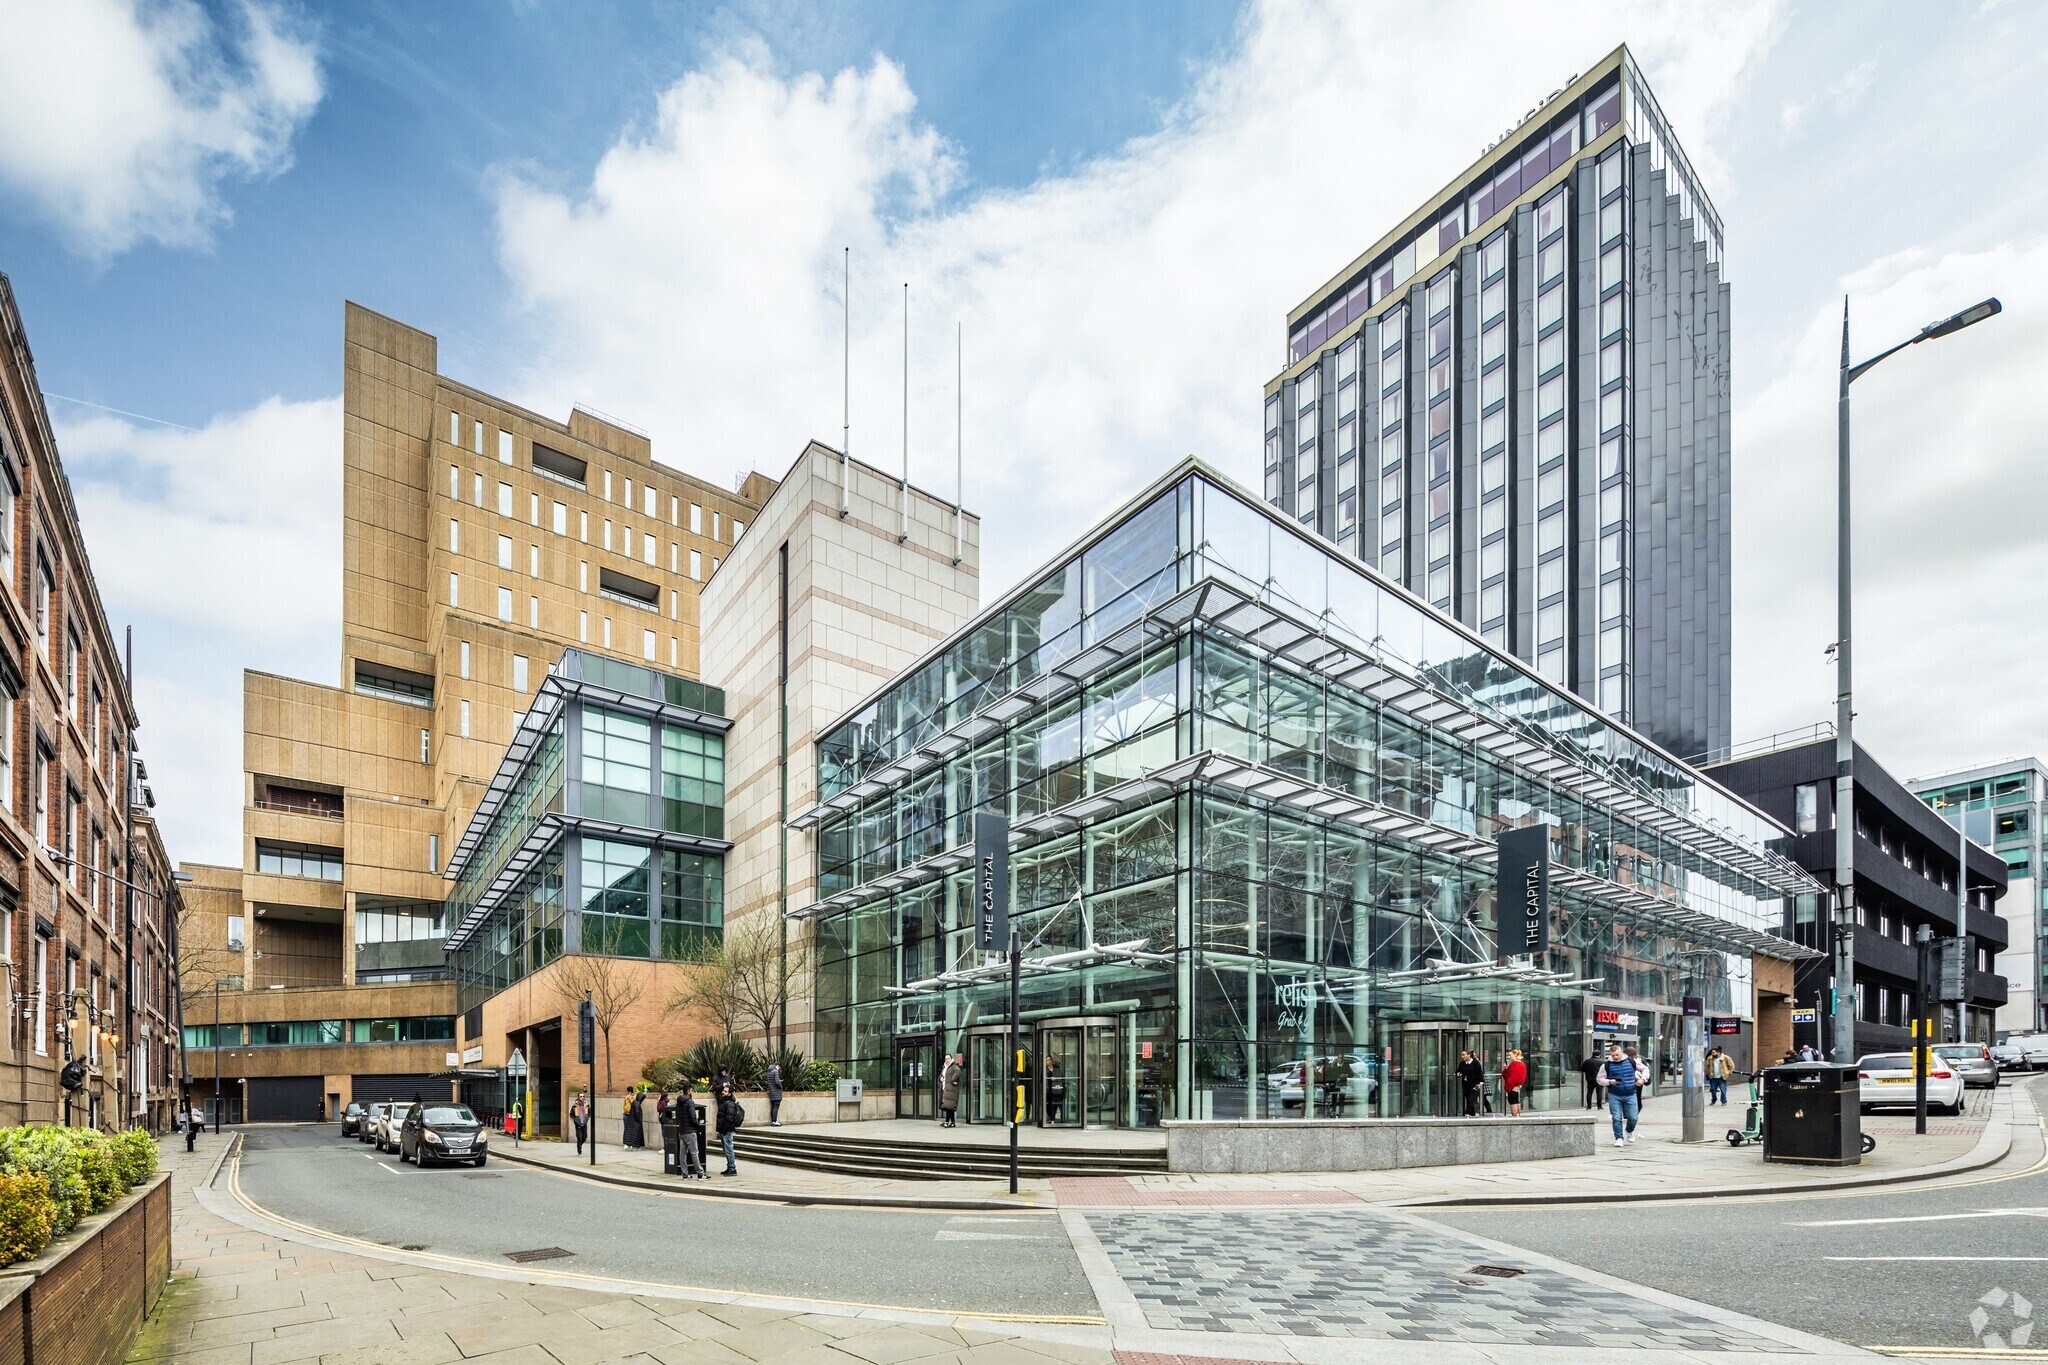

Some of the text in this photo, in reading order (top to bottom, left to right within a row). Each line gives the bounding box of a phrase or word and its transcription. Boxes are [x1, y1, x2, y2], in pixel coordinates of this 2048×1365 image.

[984, 852, 994, 943] THE CAPITAL
[1526, 860, 1540, 947] THE CAPITAL
[1595, 1010, 1618, 1024] TESCO
